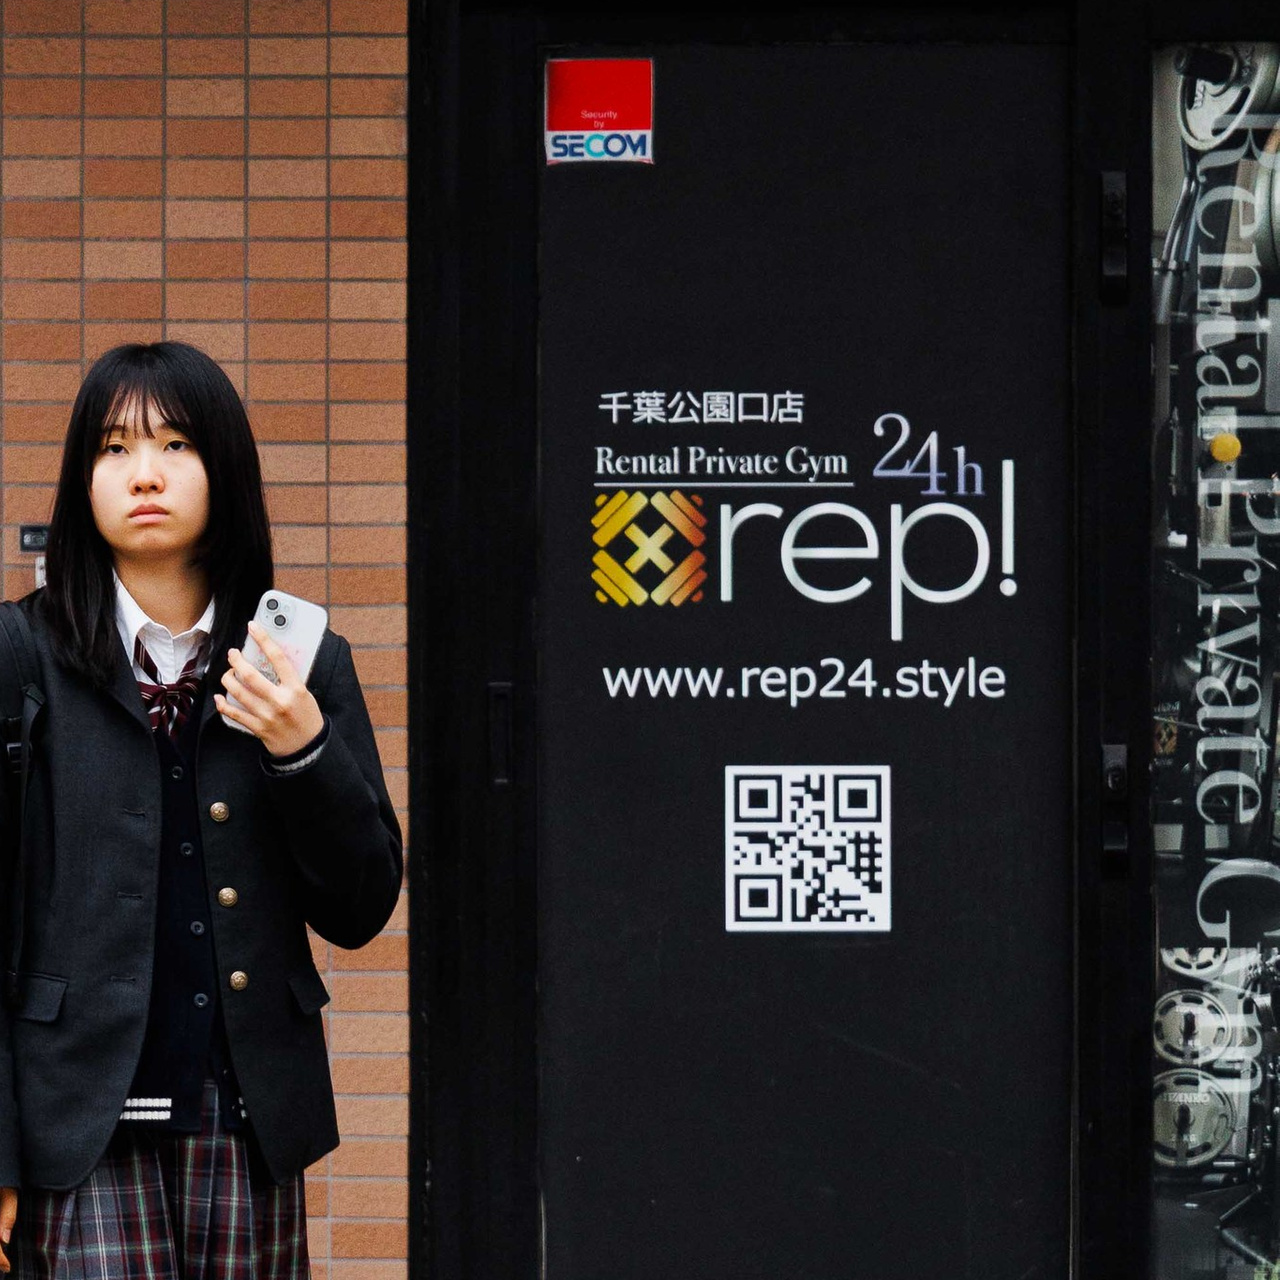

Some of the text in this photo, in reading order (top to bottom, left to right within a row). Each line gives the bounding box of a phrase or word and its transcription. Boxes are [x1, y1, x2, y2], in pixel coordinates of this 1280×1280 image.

[580, 109, 618, 120] Security
[593, 120, 605, 129] by
[551, 133, 647, 158] SECOM
[1196, 106, 1280, 439] Rental
[598, 390, 804, 424] 千葉公園口店
[596, 446, 848, 483] Rental Private Gym
[872, 412, 984, 496] 24h
[720, 459, 1018, 642] rep!
[1196, 468, 1280, 824] Private
[602, 656, 1007, 708] www.rep24.style
